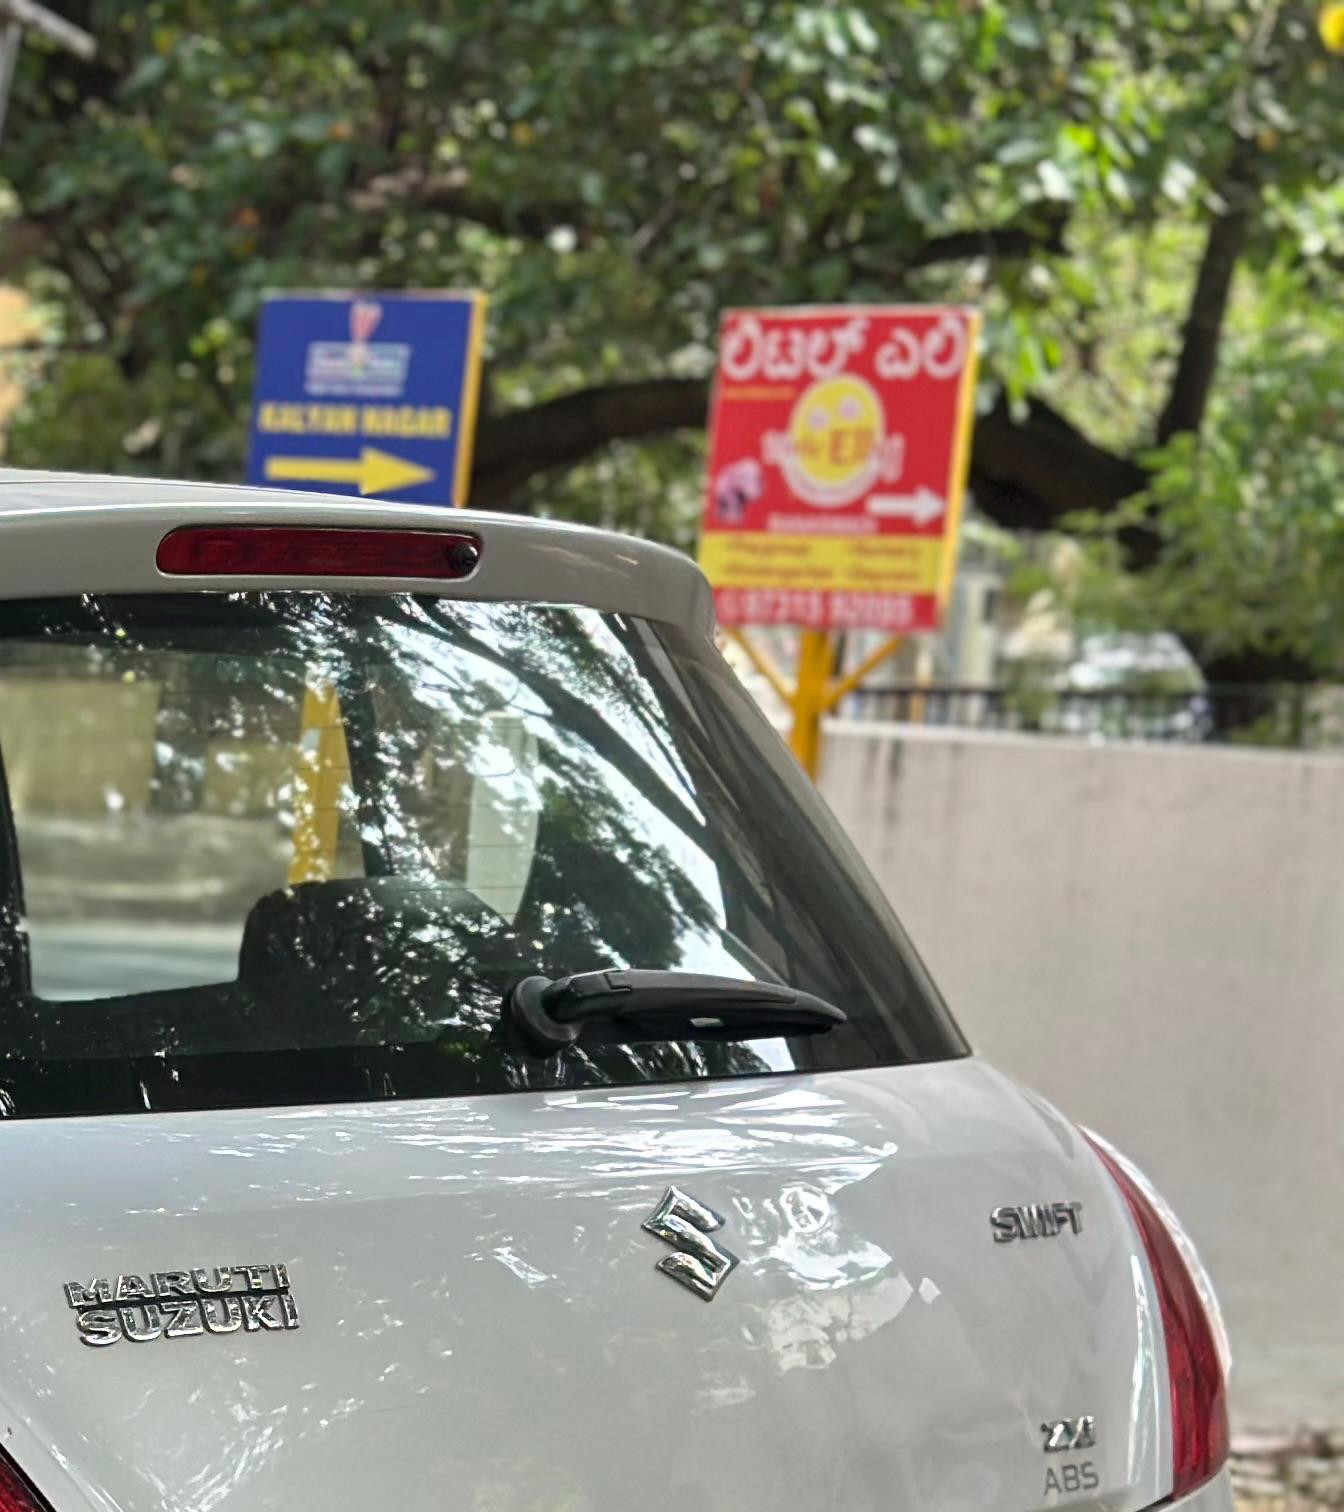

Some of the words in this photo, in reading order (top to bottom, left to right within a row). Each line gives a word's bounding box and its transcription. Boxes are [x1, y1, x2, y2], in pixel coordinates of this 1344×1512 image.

[990, 1201, 1082, 1242] SWIFT
[63, 1263, 291, 1308] MARUTI
[76, 1291, 300, 1346] SUZUKI
[1043, 1461, 1100, 1496] ABS
